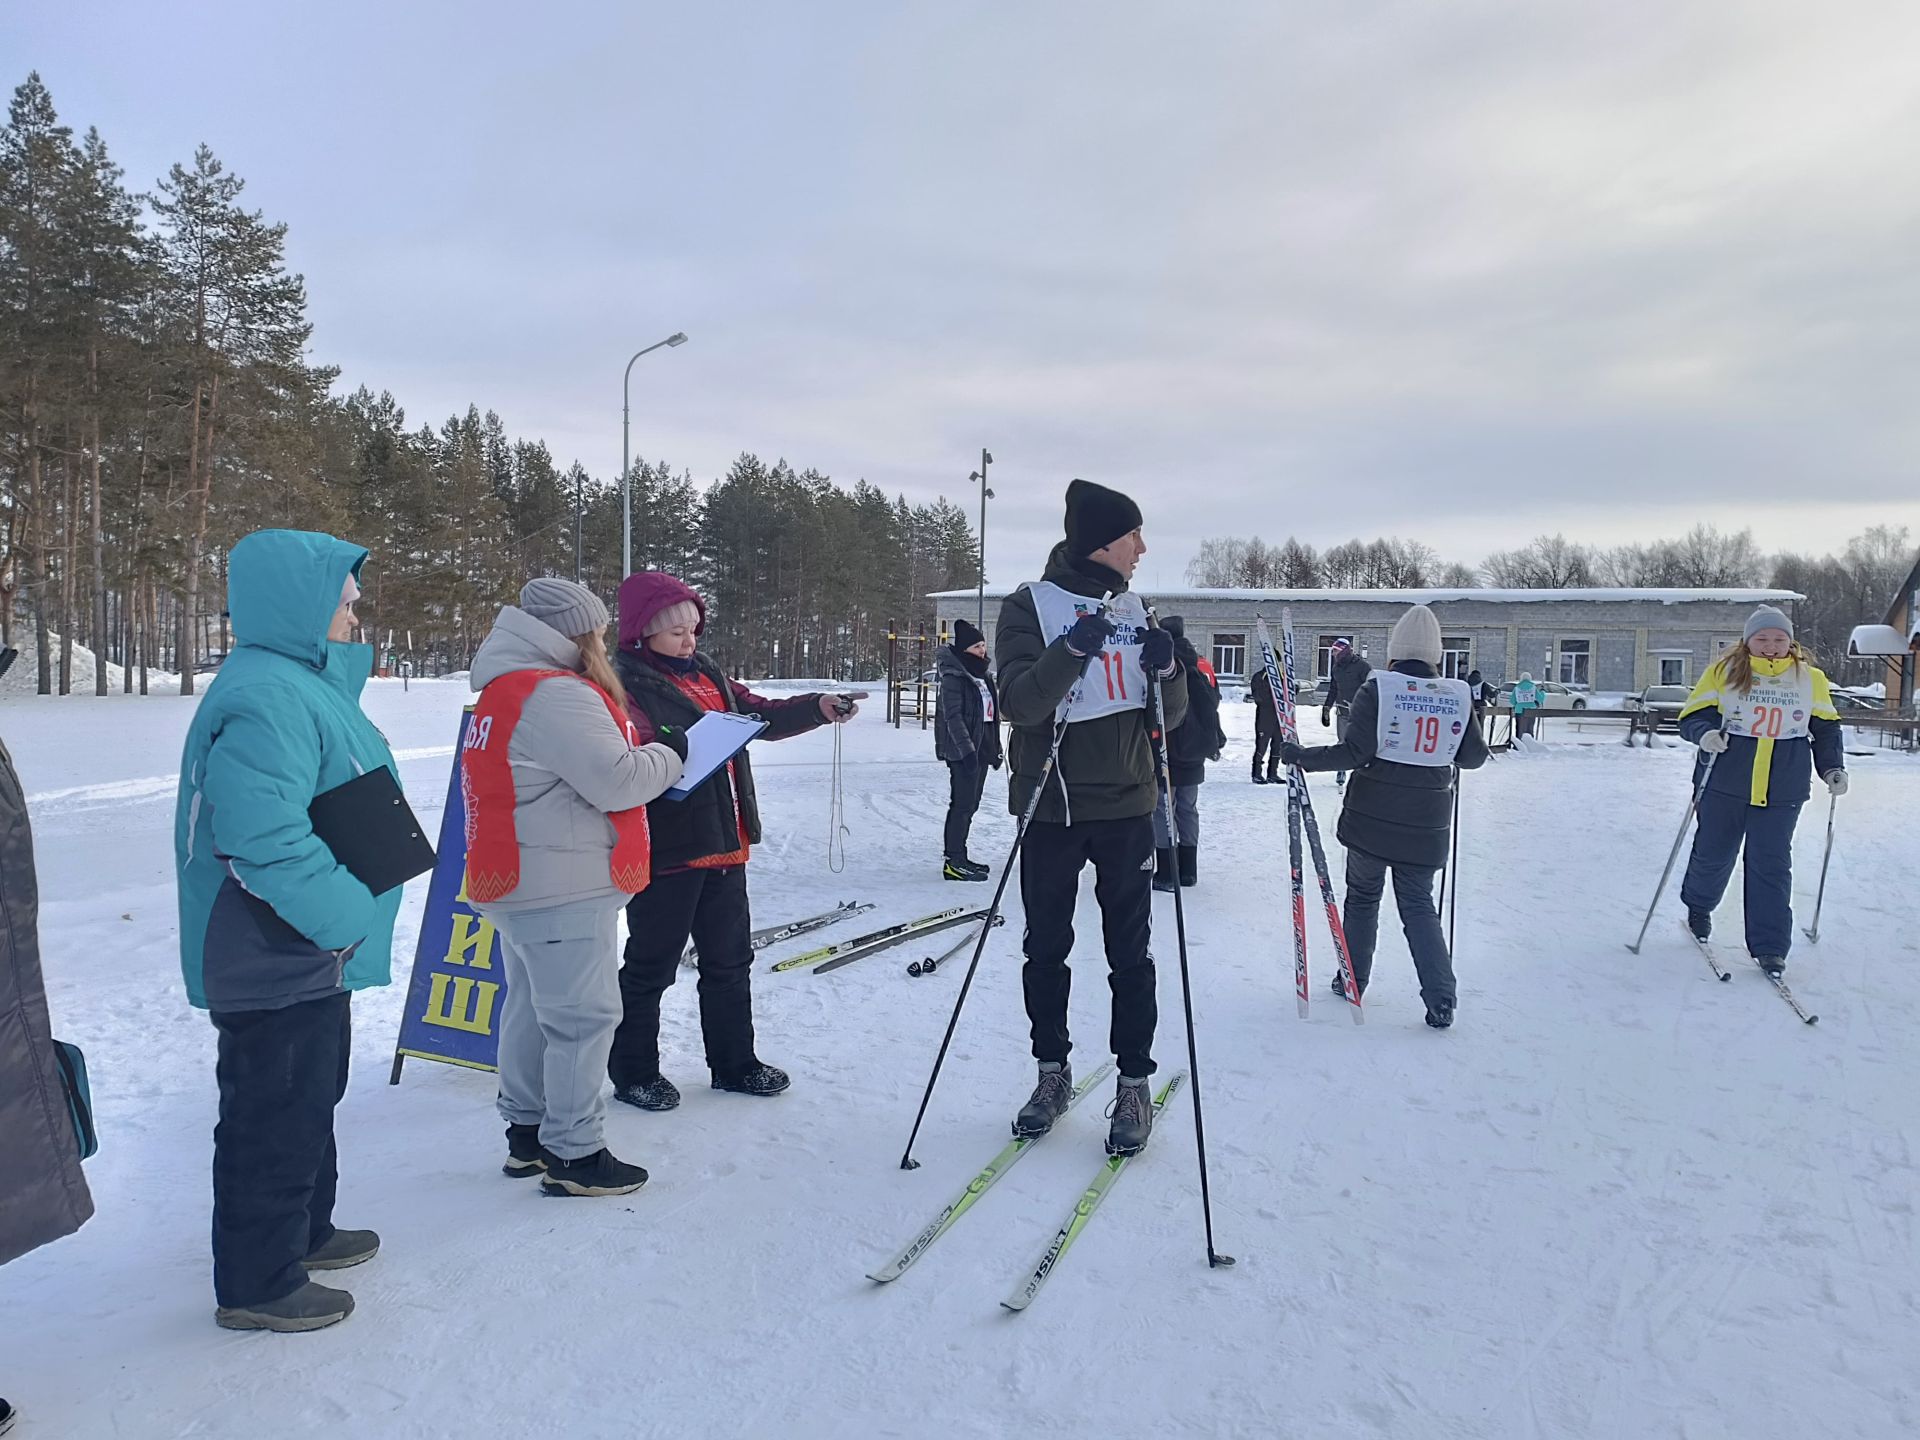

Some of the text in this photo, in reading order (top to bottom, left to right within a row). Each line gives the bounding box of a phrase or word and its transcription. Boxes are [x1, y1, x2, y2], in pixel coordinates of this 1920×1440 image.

[1103, 650, 1127, 701] 11
[1394, 694, 1433, 703] ЛЫЖНАЯ
[1394, 702, 1459, 715] «ТРЕХГОРКА»
[1415, 716, 1440, 753] 19
[1750, 705, 1782, 738] 20
